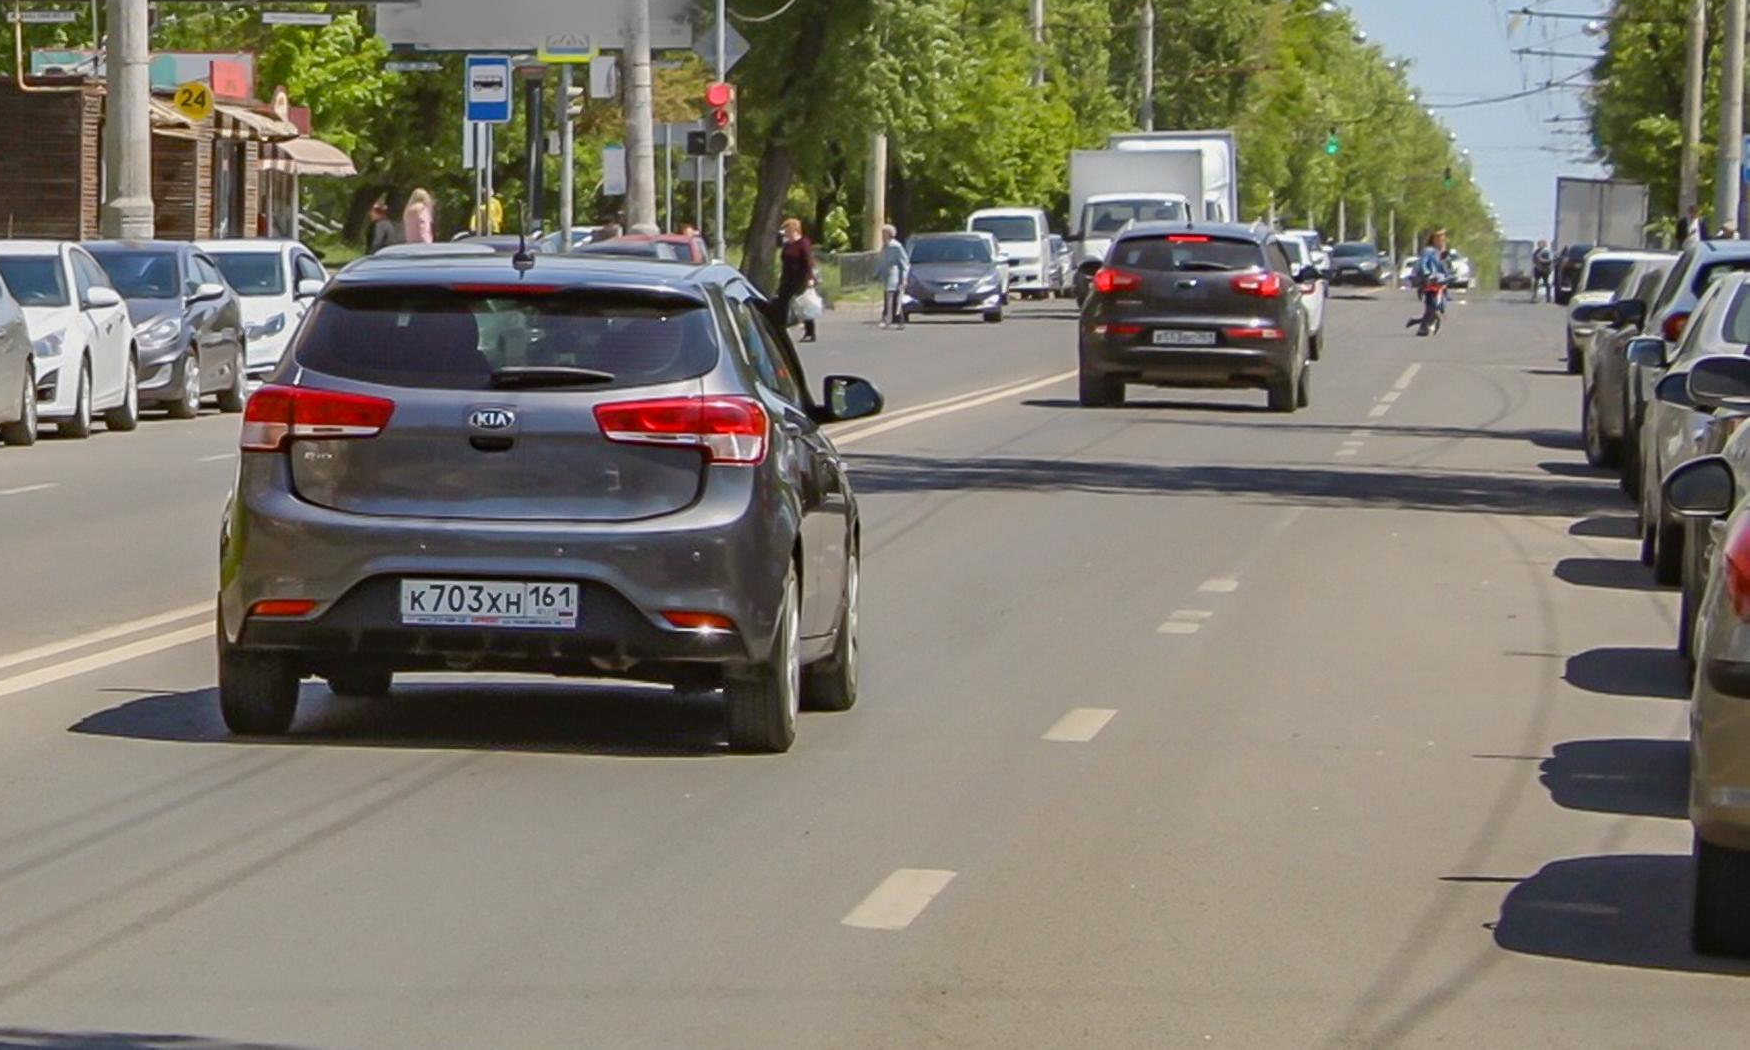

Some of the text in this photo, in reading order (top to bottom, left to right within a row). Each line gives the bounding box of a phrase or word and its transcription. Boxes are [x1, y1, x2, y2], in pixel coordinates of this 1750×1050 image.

[179, 88, 207, 109] 24
[476, 411, 508, 427] KIA
[528, 585, 571, 608] 161
